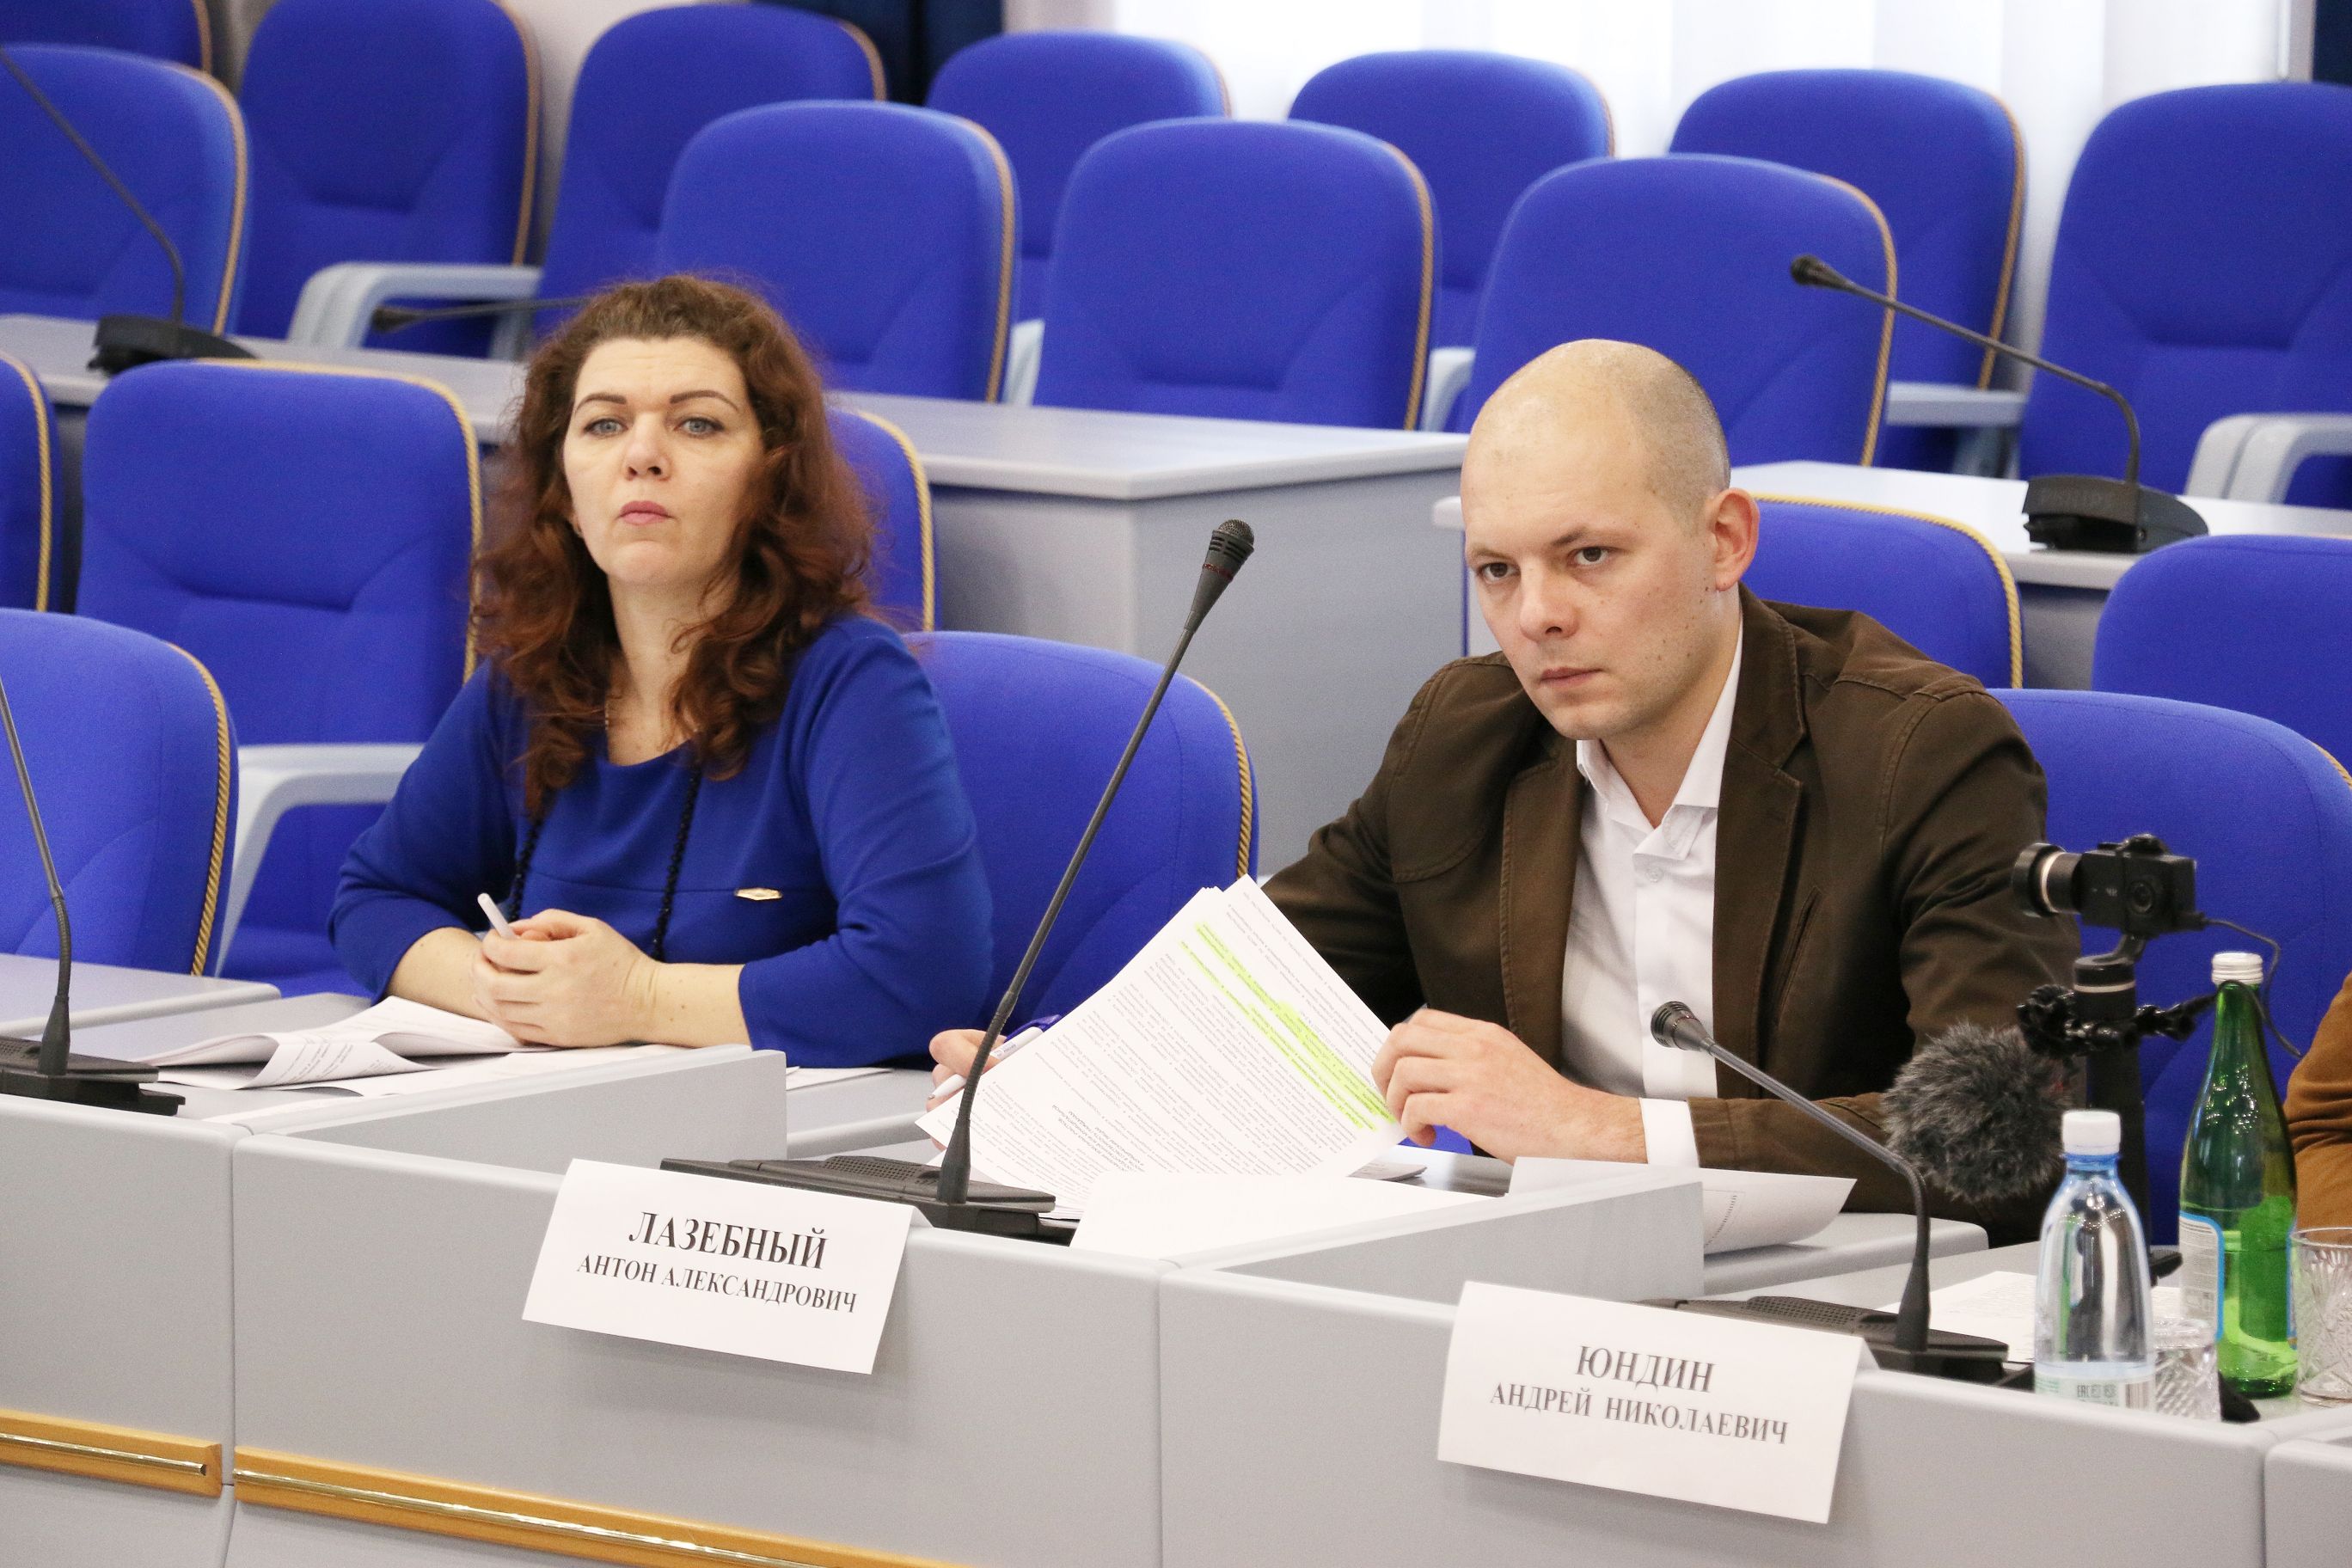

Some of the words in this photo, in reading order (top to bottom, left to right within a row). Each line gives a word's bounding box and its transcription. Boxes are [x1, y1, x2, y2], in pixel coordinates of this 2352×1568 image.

[628, 1211, 828, 1270] ЛАЗЕБНЫЙ
[577, 1254, 658, 1283] АНТОН
[660, 1267, 857, 1314] АЛЕКСАНДРОВИЧ
[1575, 1345, 1716, 1393] ЮНДИН
[1491, 1383, 1592, 1417] АНДРЕЙ
[1605, 1397, 1789, 1445] НИКОЛАЕВИЧ
